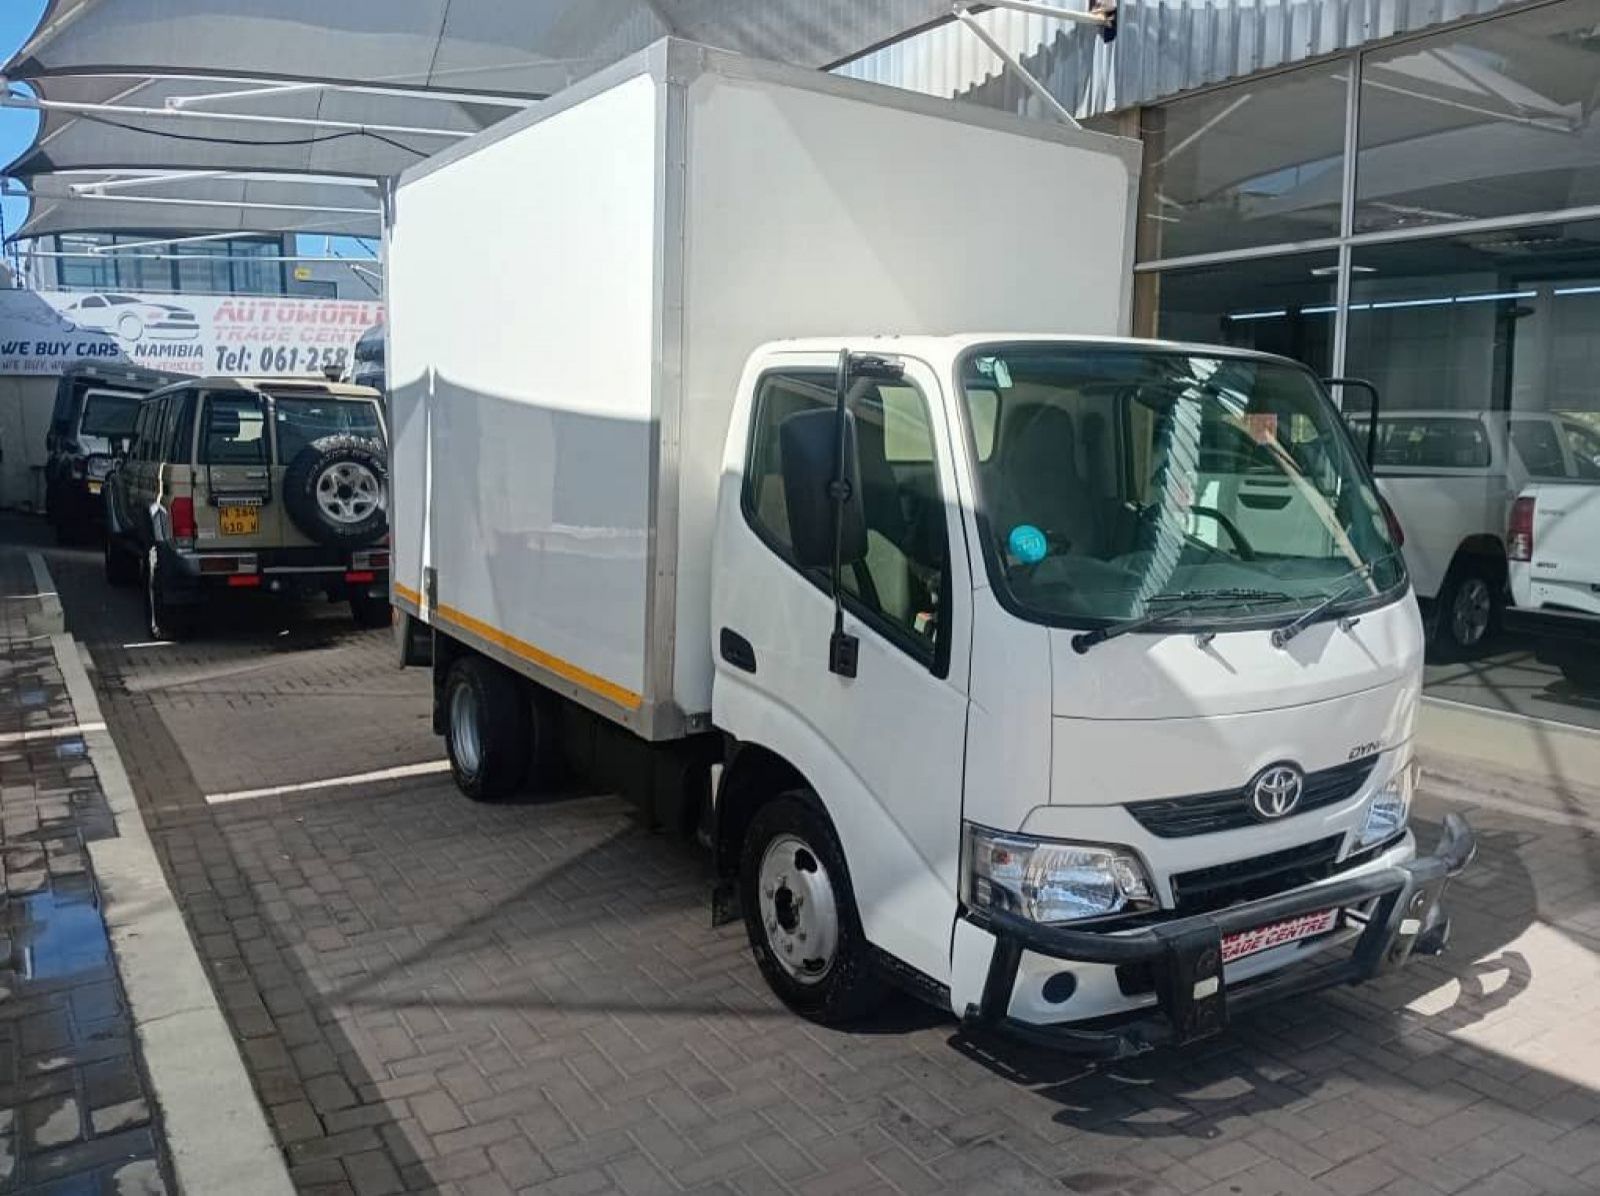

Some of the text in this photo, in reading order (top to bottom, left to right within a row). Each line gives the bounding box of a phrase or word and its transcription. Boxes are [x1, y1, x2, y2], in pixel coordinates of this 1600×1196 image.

[213, 326, 294, 342] TRADE
[1, 341, 203, 357] WE BUY CARS NAMIBIA
[215, 345, 251, 372] Tel:
